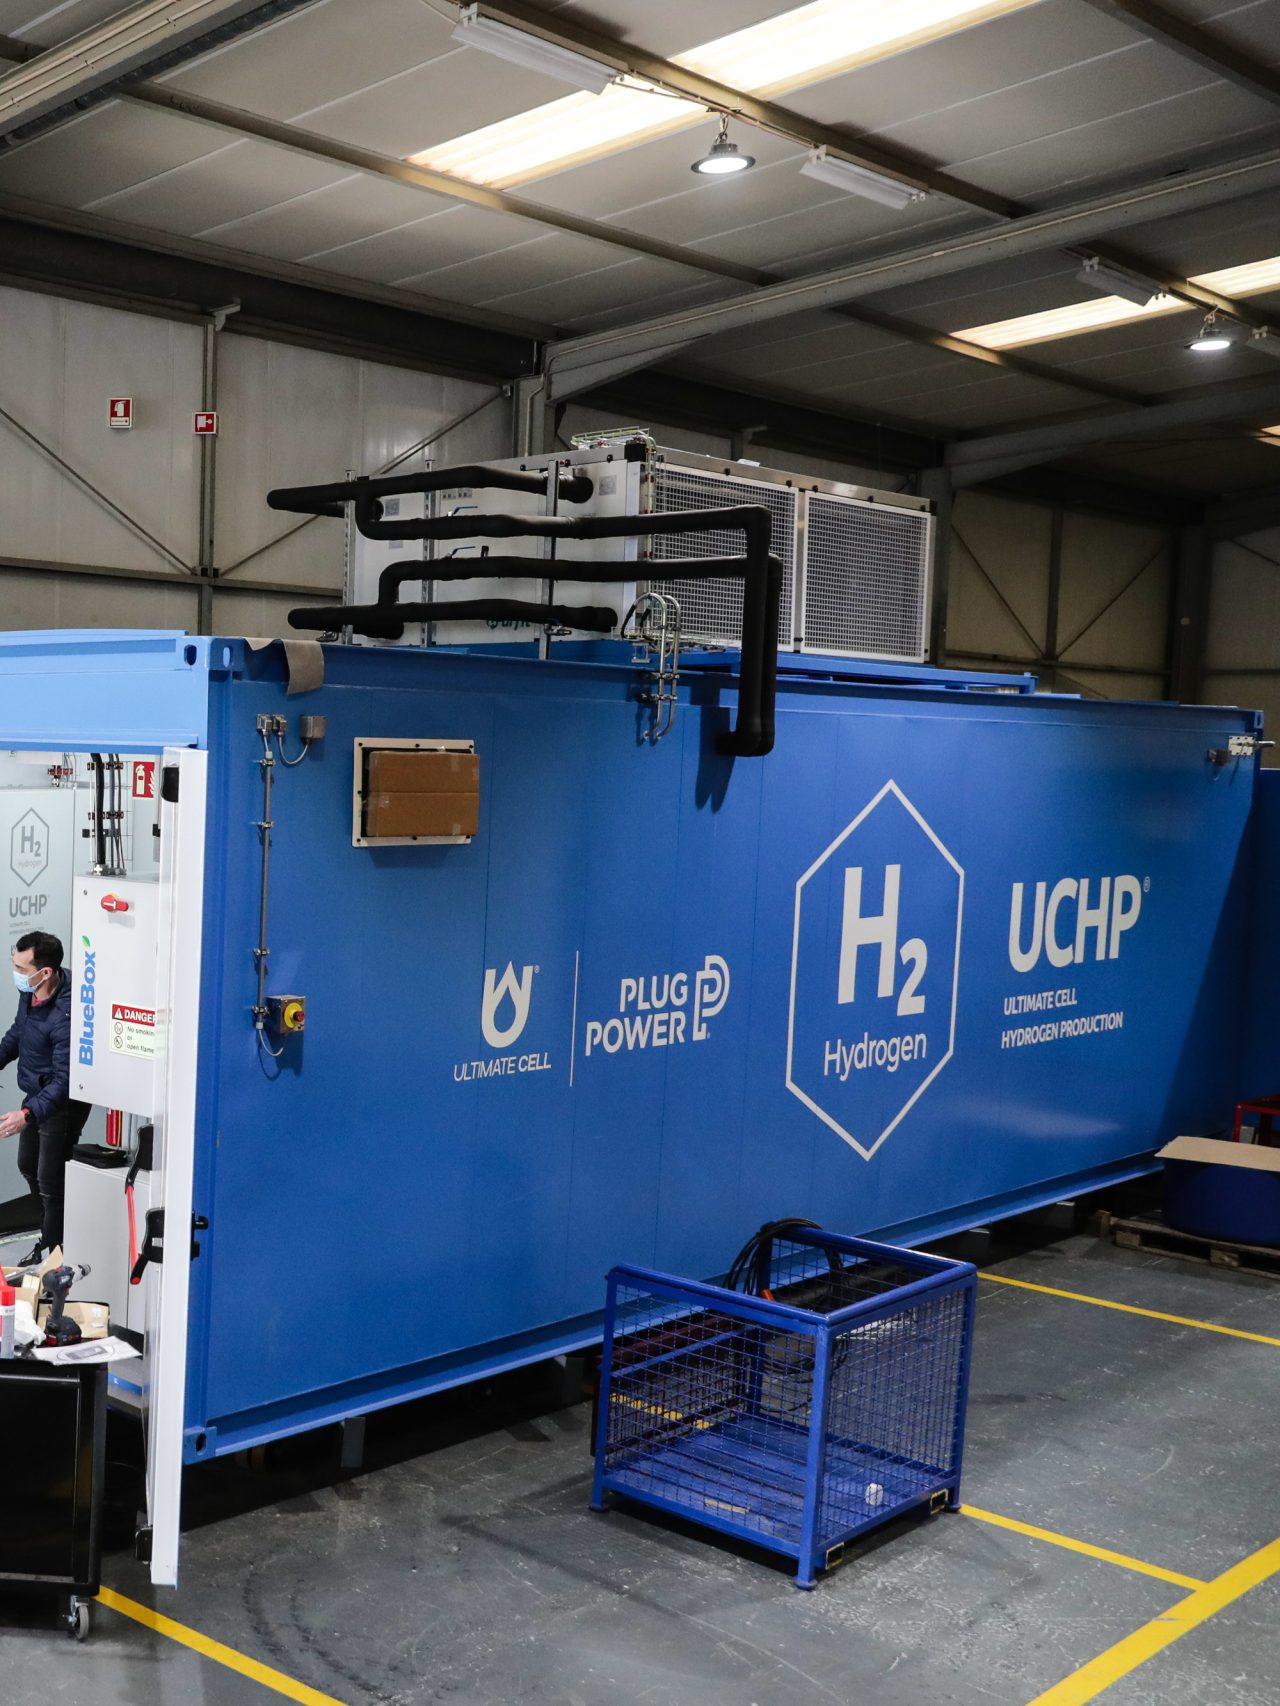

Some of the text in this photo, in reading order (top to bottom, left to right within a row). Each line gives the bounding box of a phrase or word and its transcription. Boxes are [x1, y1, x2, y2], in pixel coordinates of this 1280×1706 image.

[79, 950, 96, 1067] BlueBox
[620, 972, 688, 1012] PLUG
[1004, 988, 1078, 1015] ULTIMATE CELL
[124, 1009, 155, 1024] DANGE
[136, 1028, 155, 1036] smokin
[1001, 1011, 1123, 1049] HYDROGEN PRODUCTION
[127, 1043, 139, 1051] open
[585, 1011, 686, 1056] POWER
[453, 1052, 551, 1081] ULTIMATE CELL
[823, 1032, 927, 1081] Hydrogen
